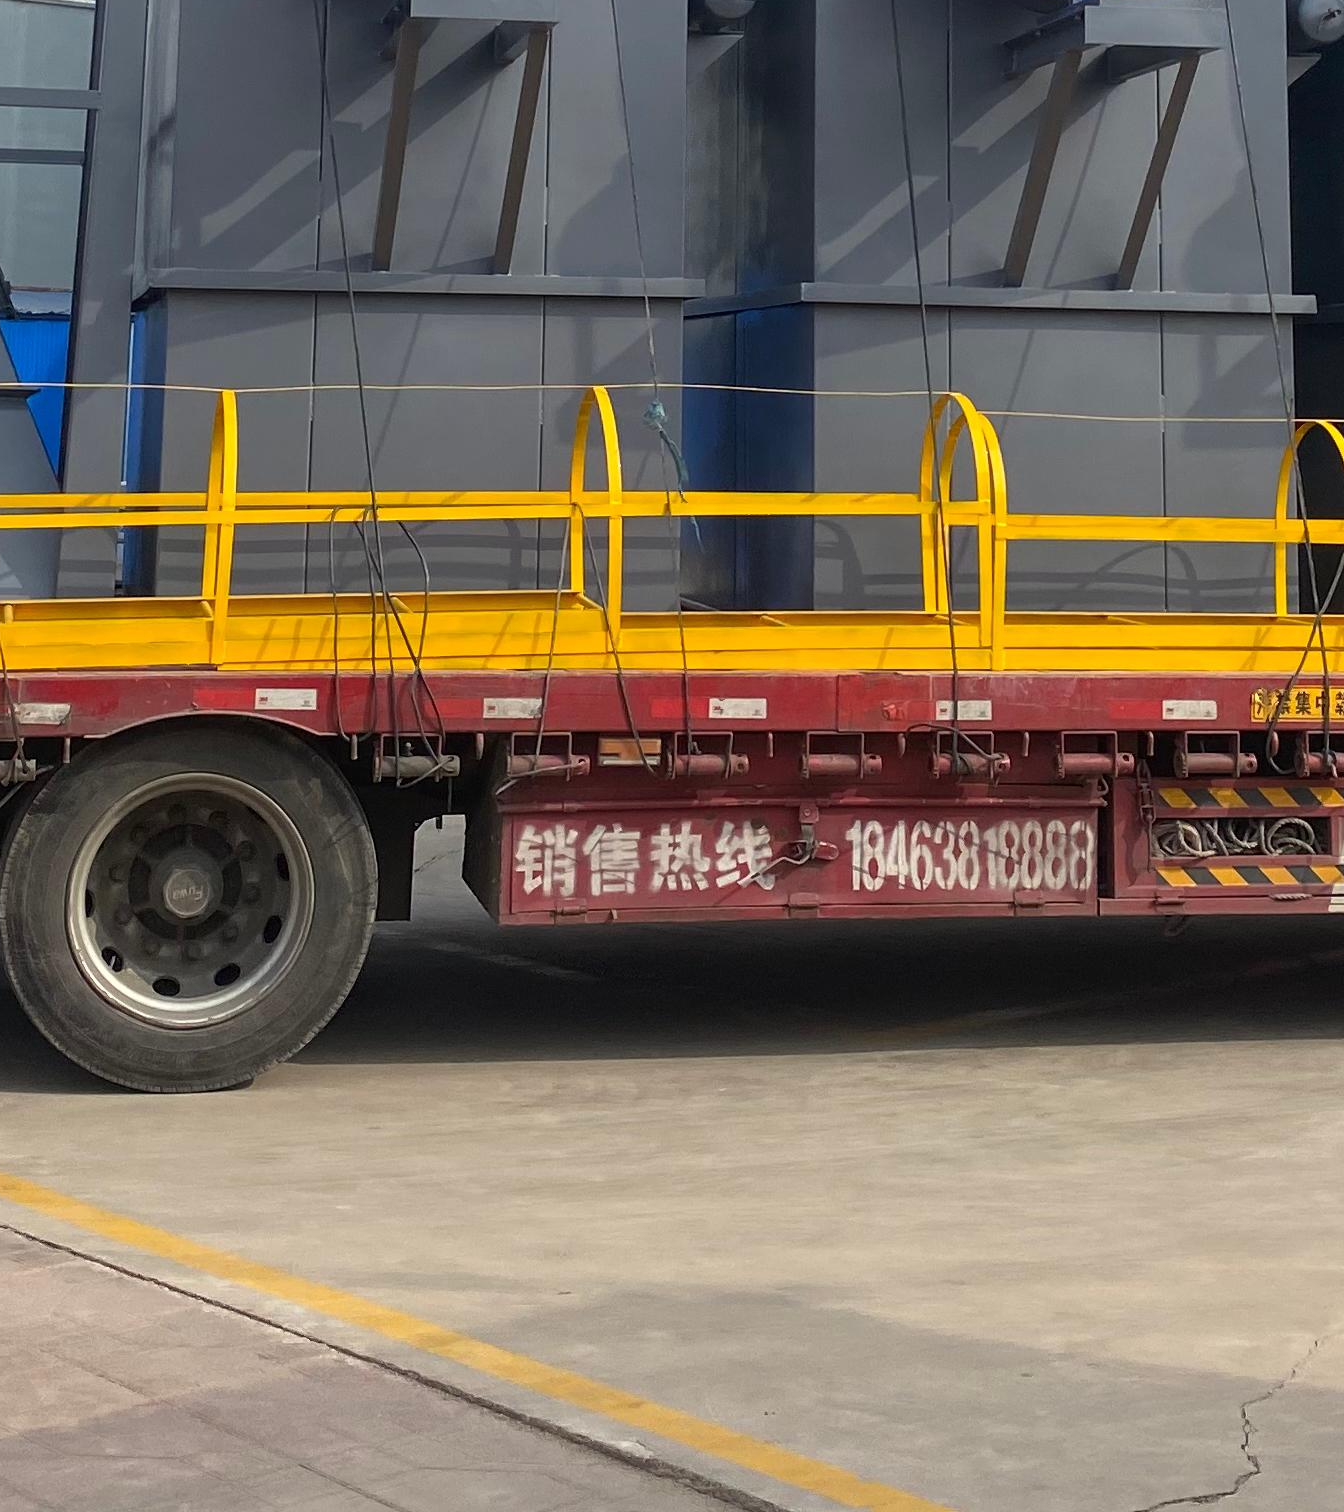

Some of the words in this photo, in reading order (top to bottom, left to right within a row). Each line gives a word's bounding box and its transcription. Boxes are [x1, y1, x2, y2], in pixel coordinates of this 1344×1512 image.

[514, 820, 776, 896] 销售热线
[845, 819, 1094, 891] 18463818888
